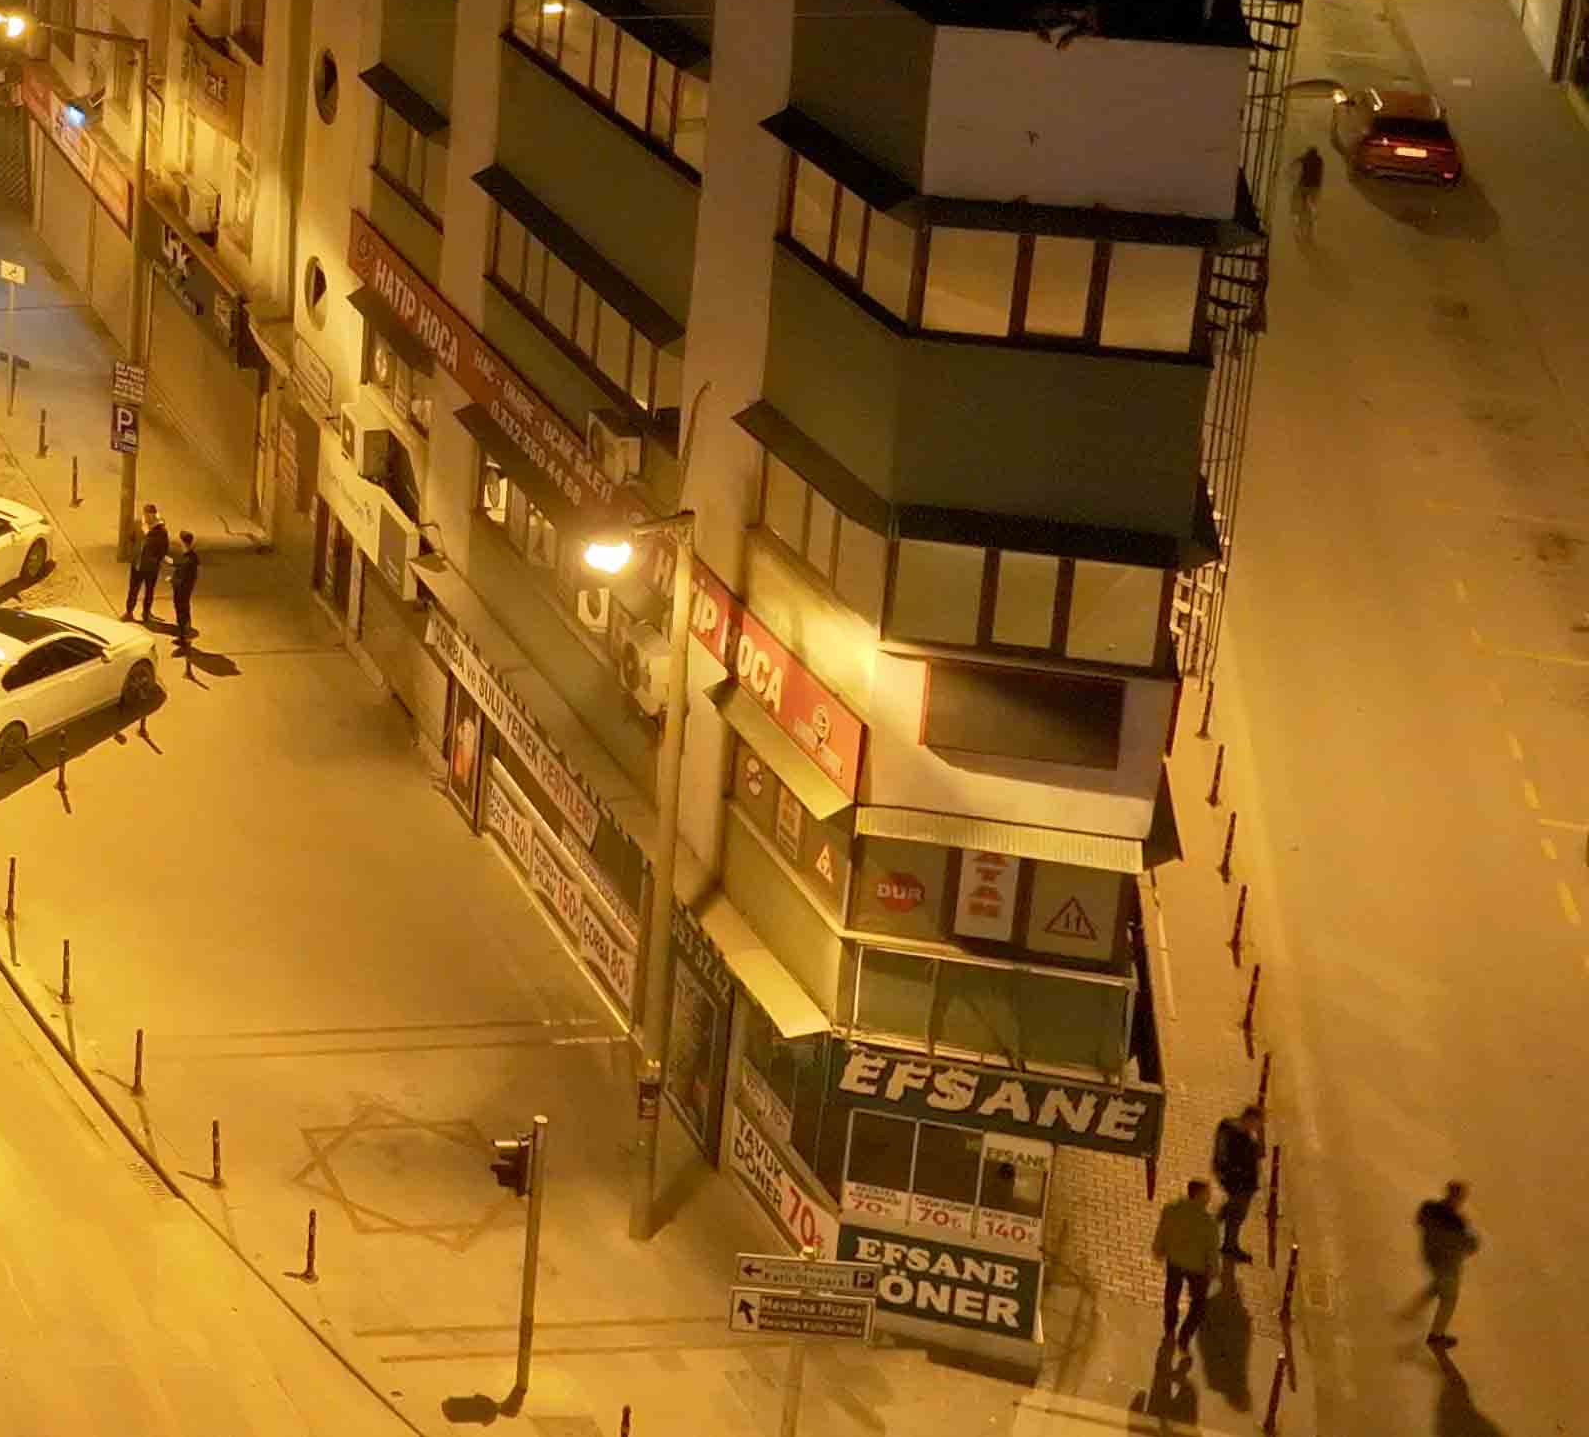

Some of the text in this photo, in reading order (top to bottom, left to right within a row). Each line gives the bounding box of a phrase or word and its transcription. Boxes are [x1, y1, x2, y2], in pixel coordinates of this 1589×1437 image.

[374, 259, 417, 323] HATİP
[418, 305, 459, 372] HOCA
[116, 406, 134, 433] P
[653, 548, 718, 632] HİP
[477, 669, 503, 717] SULU
[838, 1049, 1148, 1143] EFSANE
[854, 1235, 1019, 1291] EFSANE
[857, 1272, 872, 1286] P
[879, 1267, 1021, 1329] ÖNER
